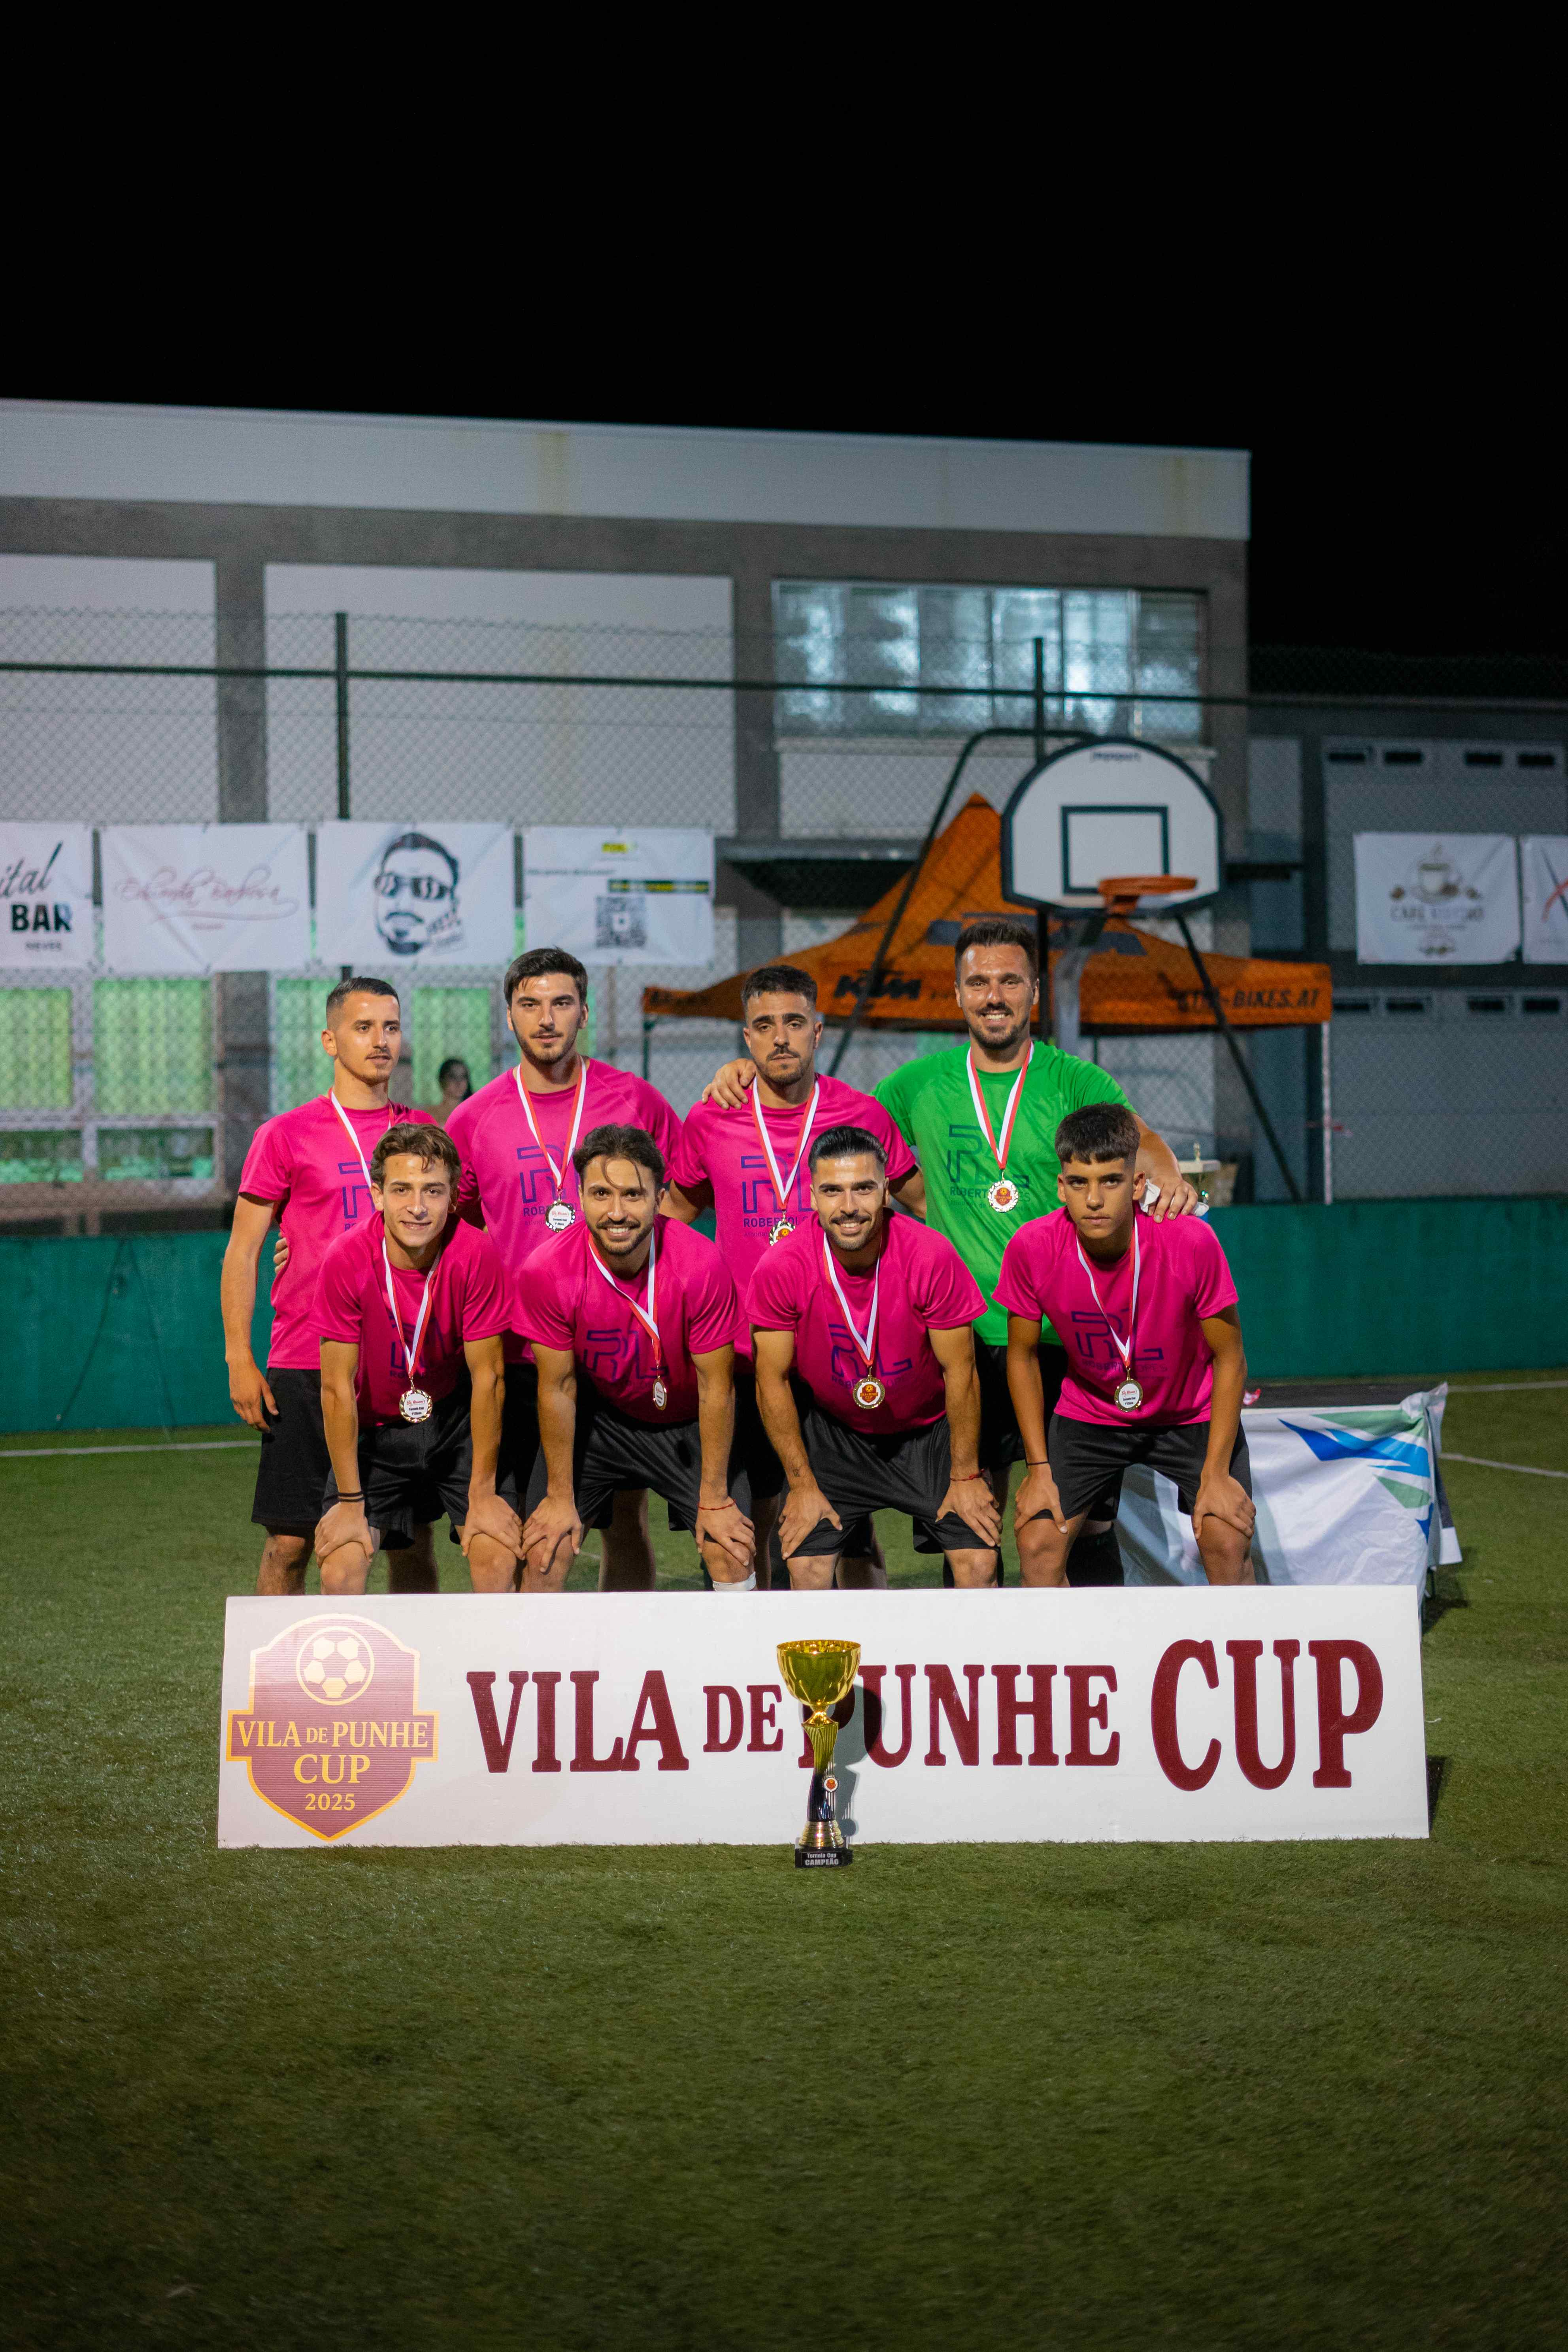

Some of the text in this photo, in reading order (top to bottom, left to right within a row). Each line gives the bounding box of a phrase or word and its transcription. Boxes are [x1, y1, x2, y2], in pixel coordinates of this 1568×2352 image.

[11, 904, 72, 932] BAR
[466, 1670, 689, 1773] VILA
[703, 1684, 783, 1753] DE
[1151, 1639, 1383, 1791] CUP
[237, 1721, 428, 1748] VILA DE PUNHE
[294, 1754, 371, 1784] CUP
[305, 1793, 355, 1810] 2025
